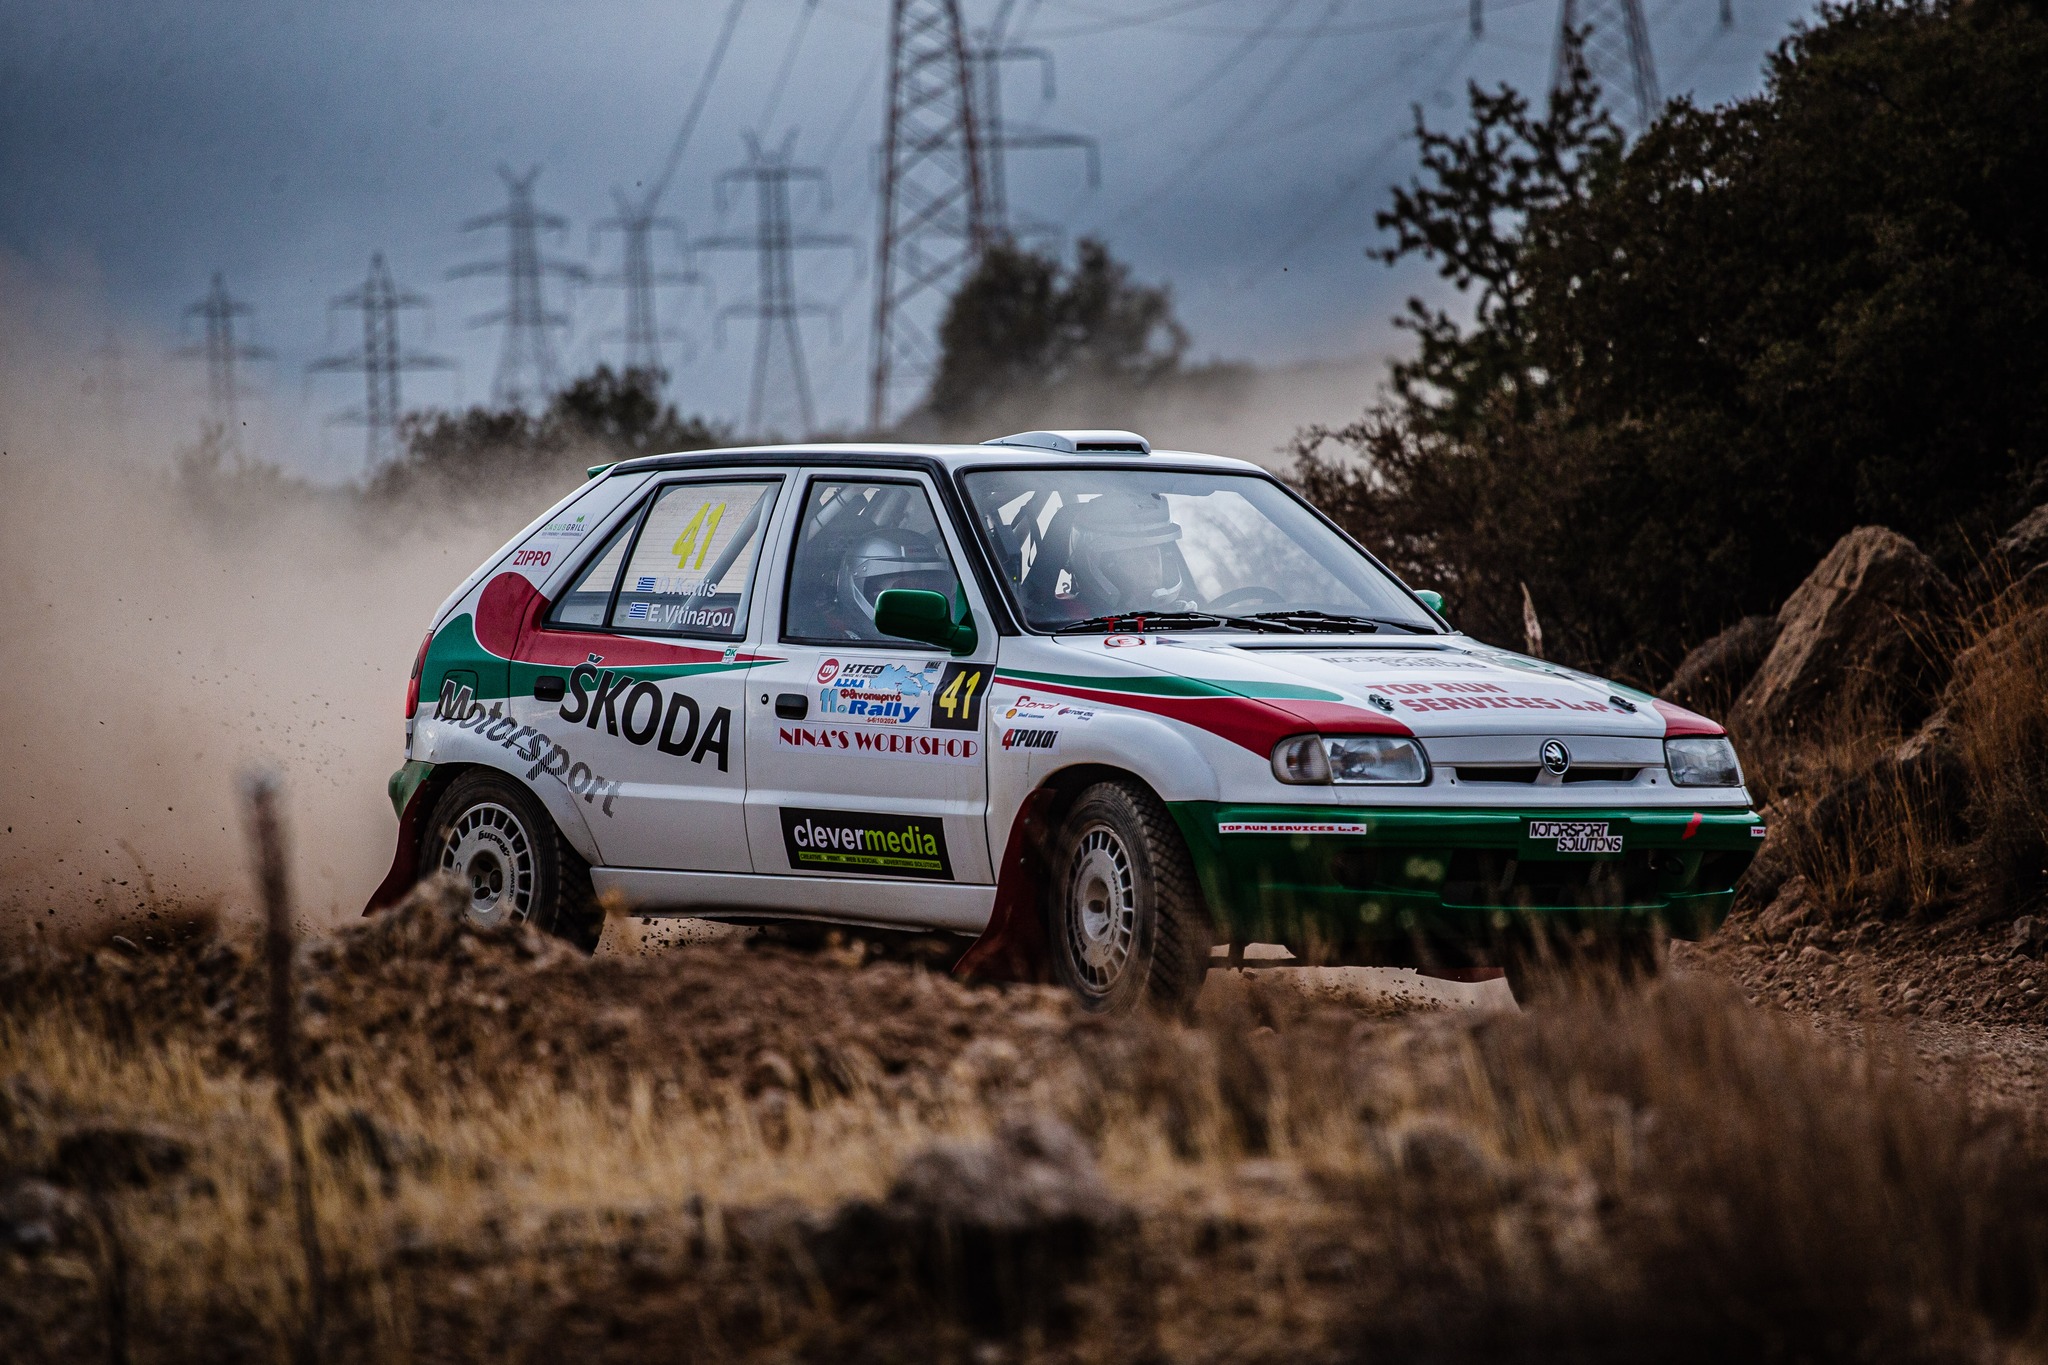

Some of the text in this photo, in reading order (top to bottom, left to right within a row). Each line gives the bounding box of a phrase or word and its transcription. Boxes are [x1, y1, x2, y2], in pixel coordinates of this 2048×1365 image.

[672, 502, 726, 570] 41
[513, 550, 551, 566] ZIPPO
[939, 671, 981, 719] 41
[1364, 682, 1509, 696] TOP RUN
[559, 653, 732, 773] ŠKODA
[849, 700, 921, 723] Rally
[1015, 695, 1060, 709] Coral
[1399, 697, 1562, 712] SERVICES
[432, 678, 623, 819] Motorsport
[779, 728, 979, 758] NINA'S WORKSHOP
[794, 818, 939, 856] clevermedia
[1531, 822, 1608, 837] MOTORSPORT
[1558, 836, 1621, 851] SOLUTIONS
